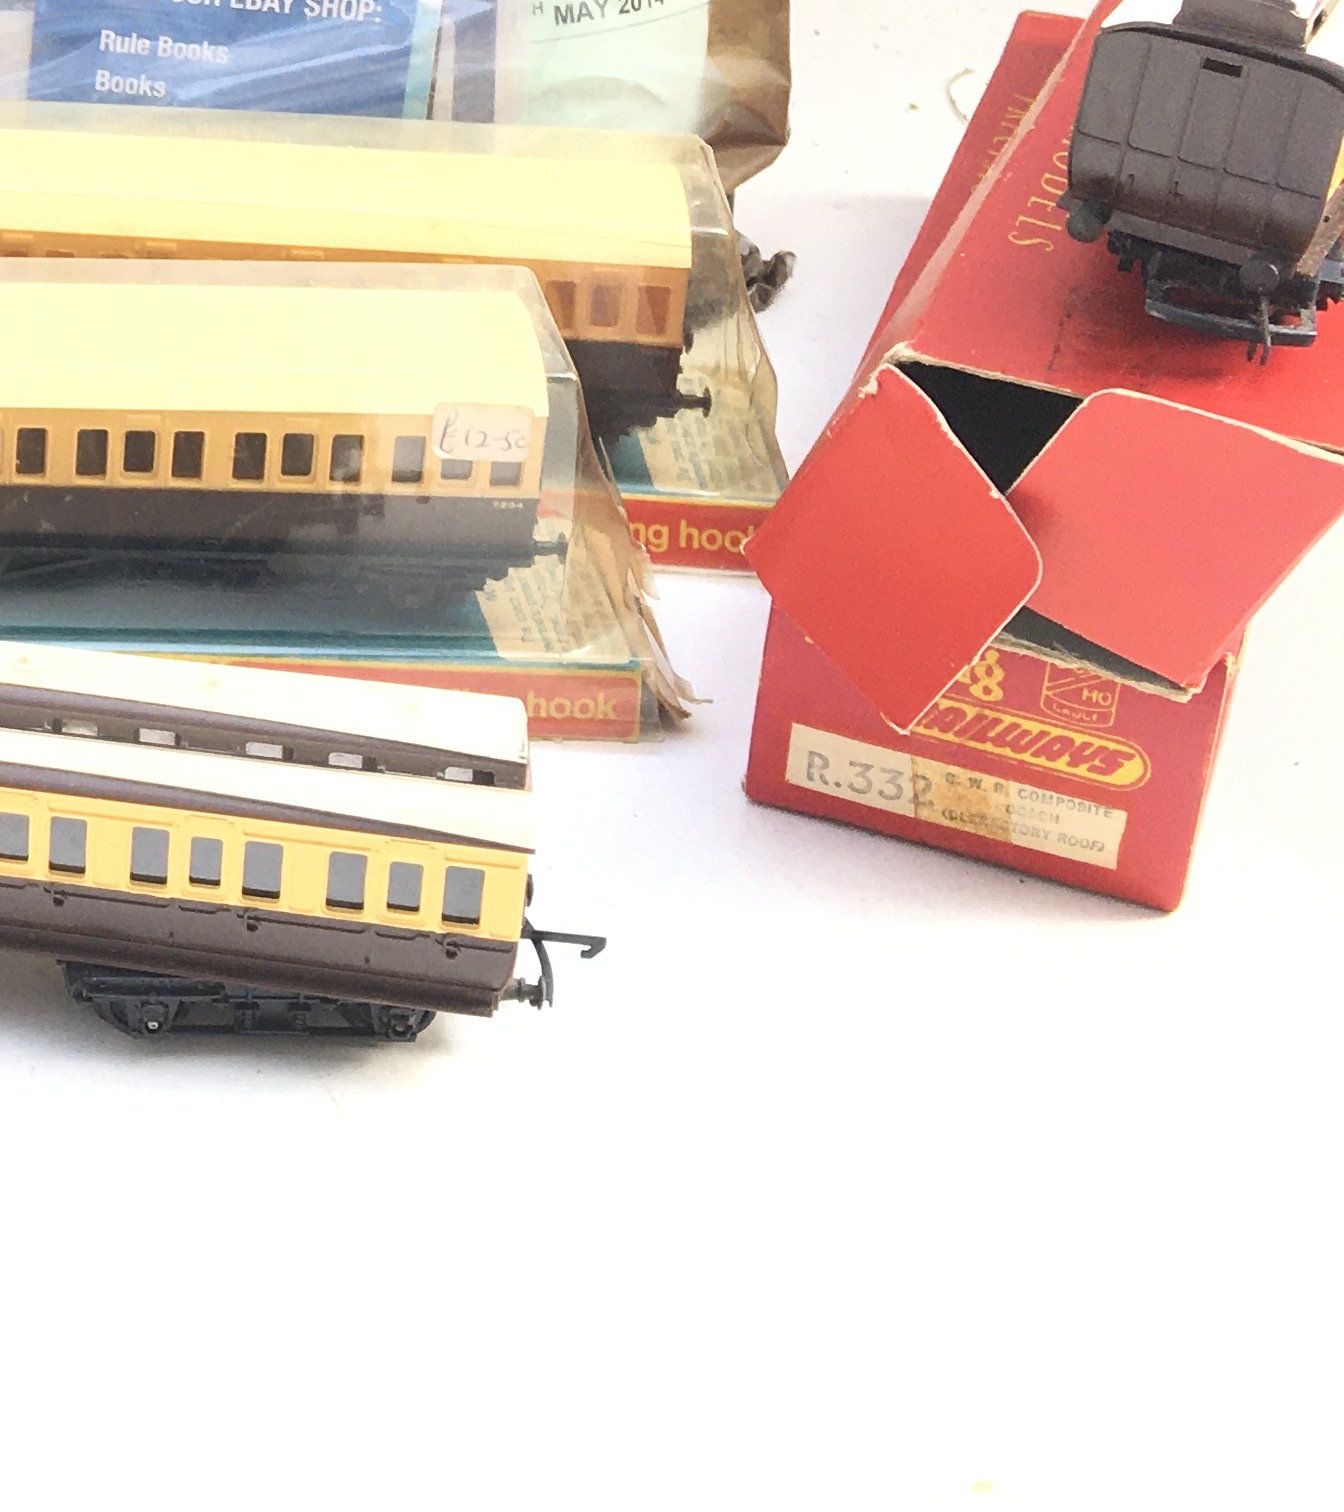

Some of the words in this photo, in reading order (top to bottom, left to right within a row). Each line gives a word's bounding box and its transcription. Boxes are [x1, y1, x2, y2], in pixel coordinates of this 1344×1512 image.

[99, 29, 151, 56] Rule
[156, 36, 230, 66] Books
[94, 69, 167, 99] Books
[678, 519, 753, 554] hoo
[527, 691, 618, 720] hook
[1081, 686, 1113, 707] HO
[921, 704, 1137, 778] AILWAYS
[805, 749, 937, 809] R.332
[1016, 788, 1114, 819] COMPOSITE
